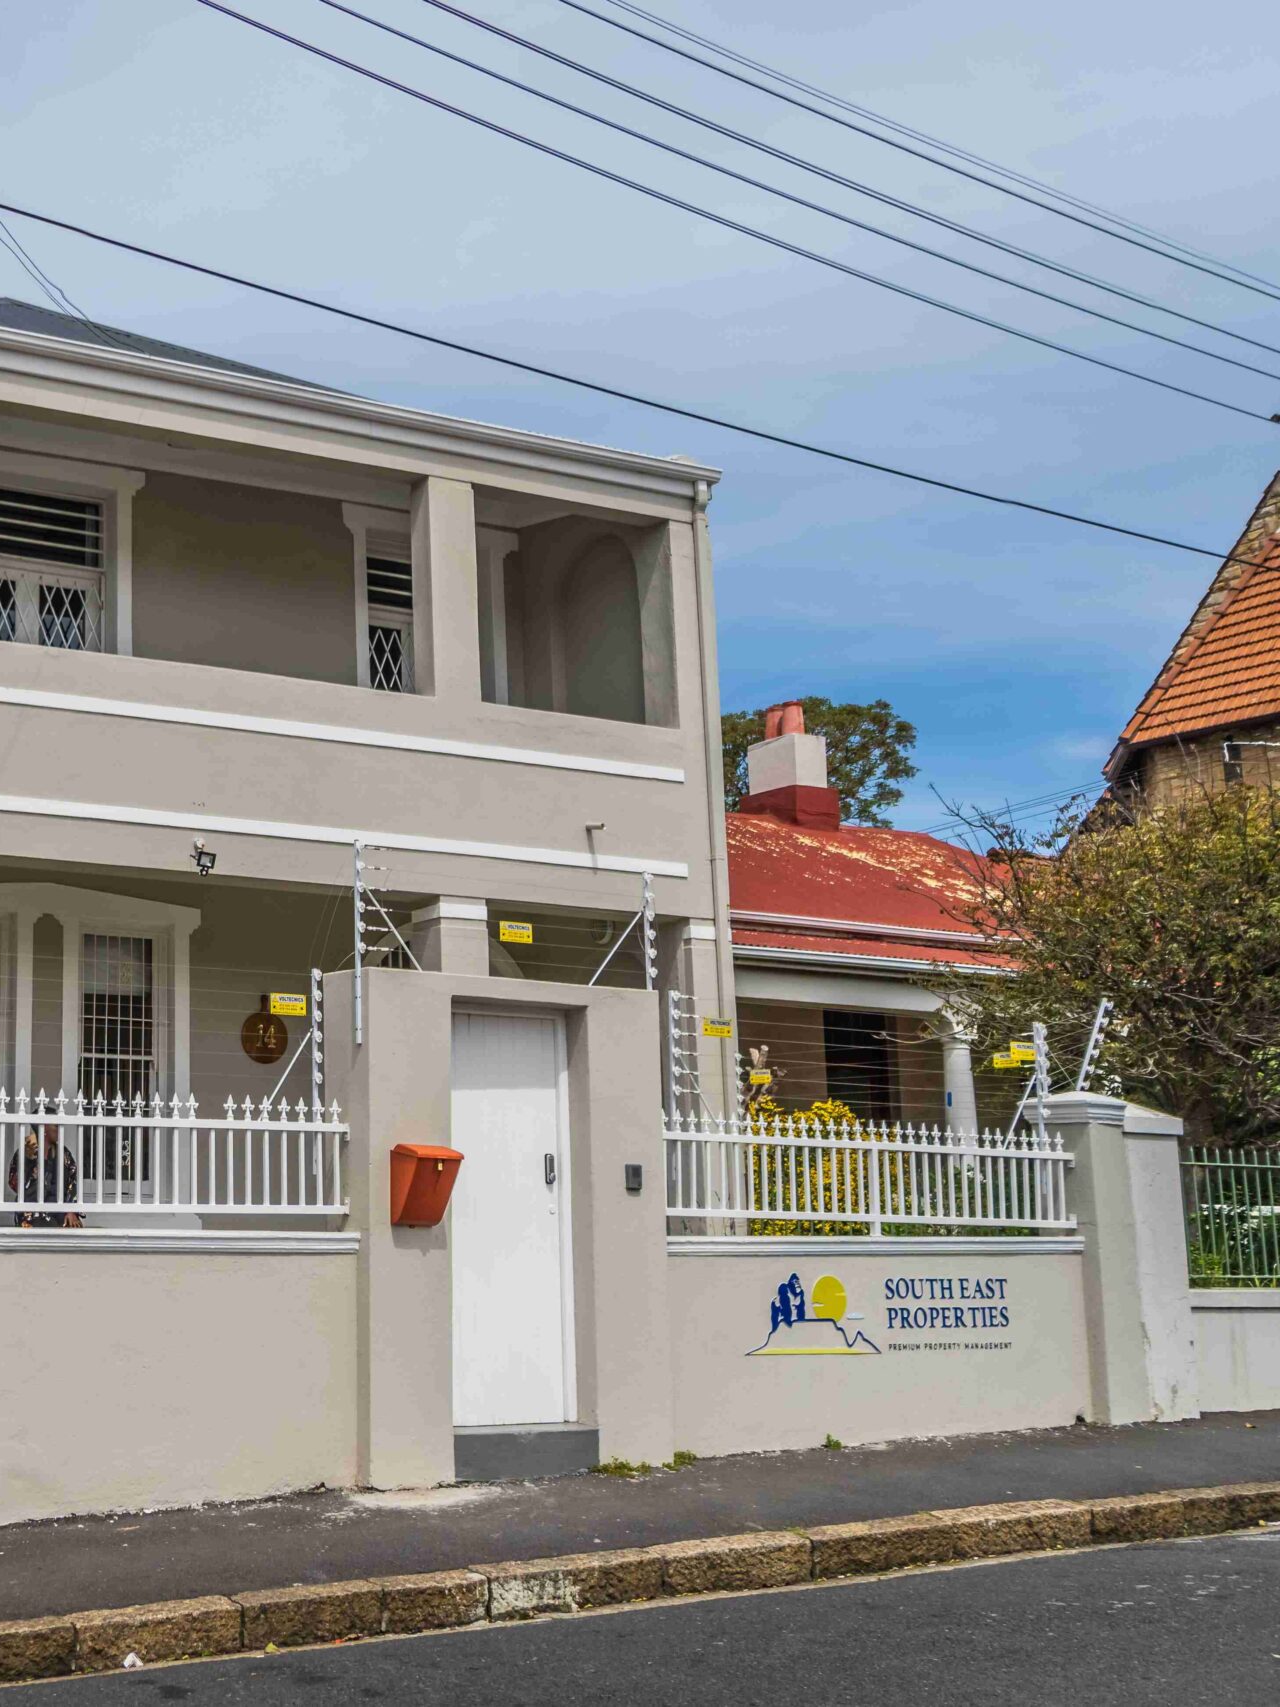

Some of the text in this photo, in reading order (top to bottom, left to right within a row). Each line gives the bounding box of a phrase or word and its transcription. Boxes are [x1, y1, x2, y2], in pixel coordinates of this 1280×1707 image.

[256, 1024, 276, 1048] 14
[884, 1278, 1008, 1300] SOUTH EAST
[887, 1306, 1010, 1329] PROPERTIES
[888, 1341, 1012, 1351] PREMIUM PROPERTY MANAGEMENT
